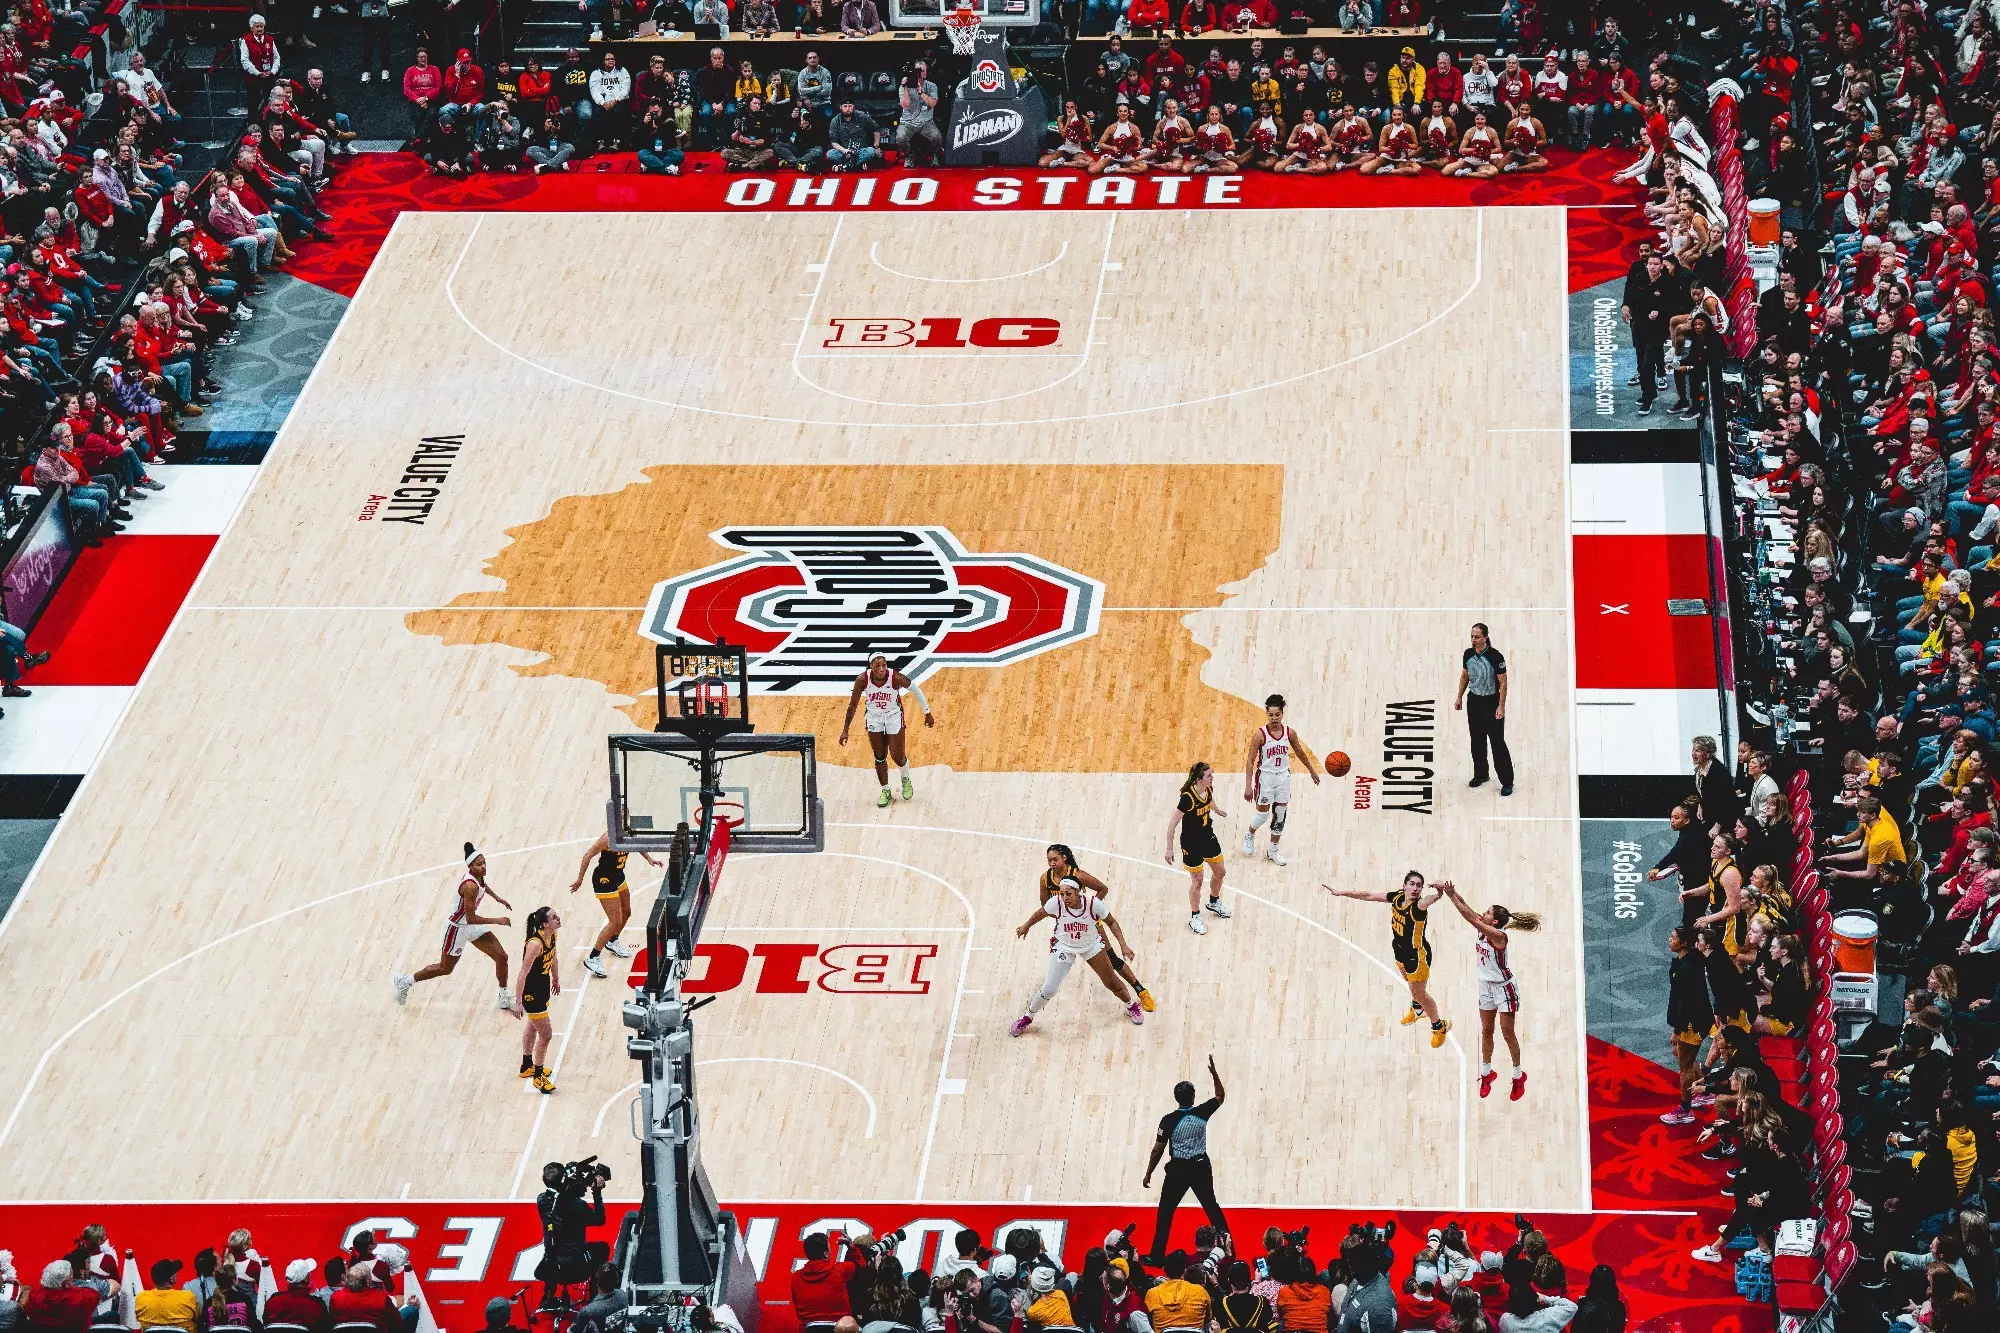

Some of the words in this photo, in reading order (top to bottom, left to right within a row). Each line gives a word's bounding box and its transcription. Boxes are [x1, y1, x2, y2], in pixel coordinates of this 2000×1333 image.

[953, 114, 1017, 150] LIBMAN
[724, 178, 939, 206] OHIO
[972, 176, 1245, 205] STATE
[1588, 297, 1619, 415] OhioStateBuckeyes.com
[400, 435, 465, 484] VALUE
[358, 494, 388, 522] Arena
[382, 486, 440, 525] CITY
[1384, 699, 1435, 763] VALUE
[1354, 775, 1378, 810] Arena
[1382, 766, 1433, 815] CITY
[1612, 840, 1645, 919] #GoBucks
